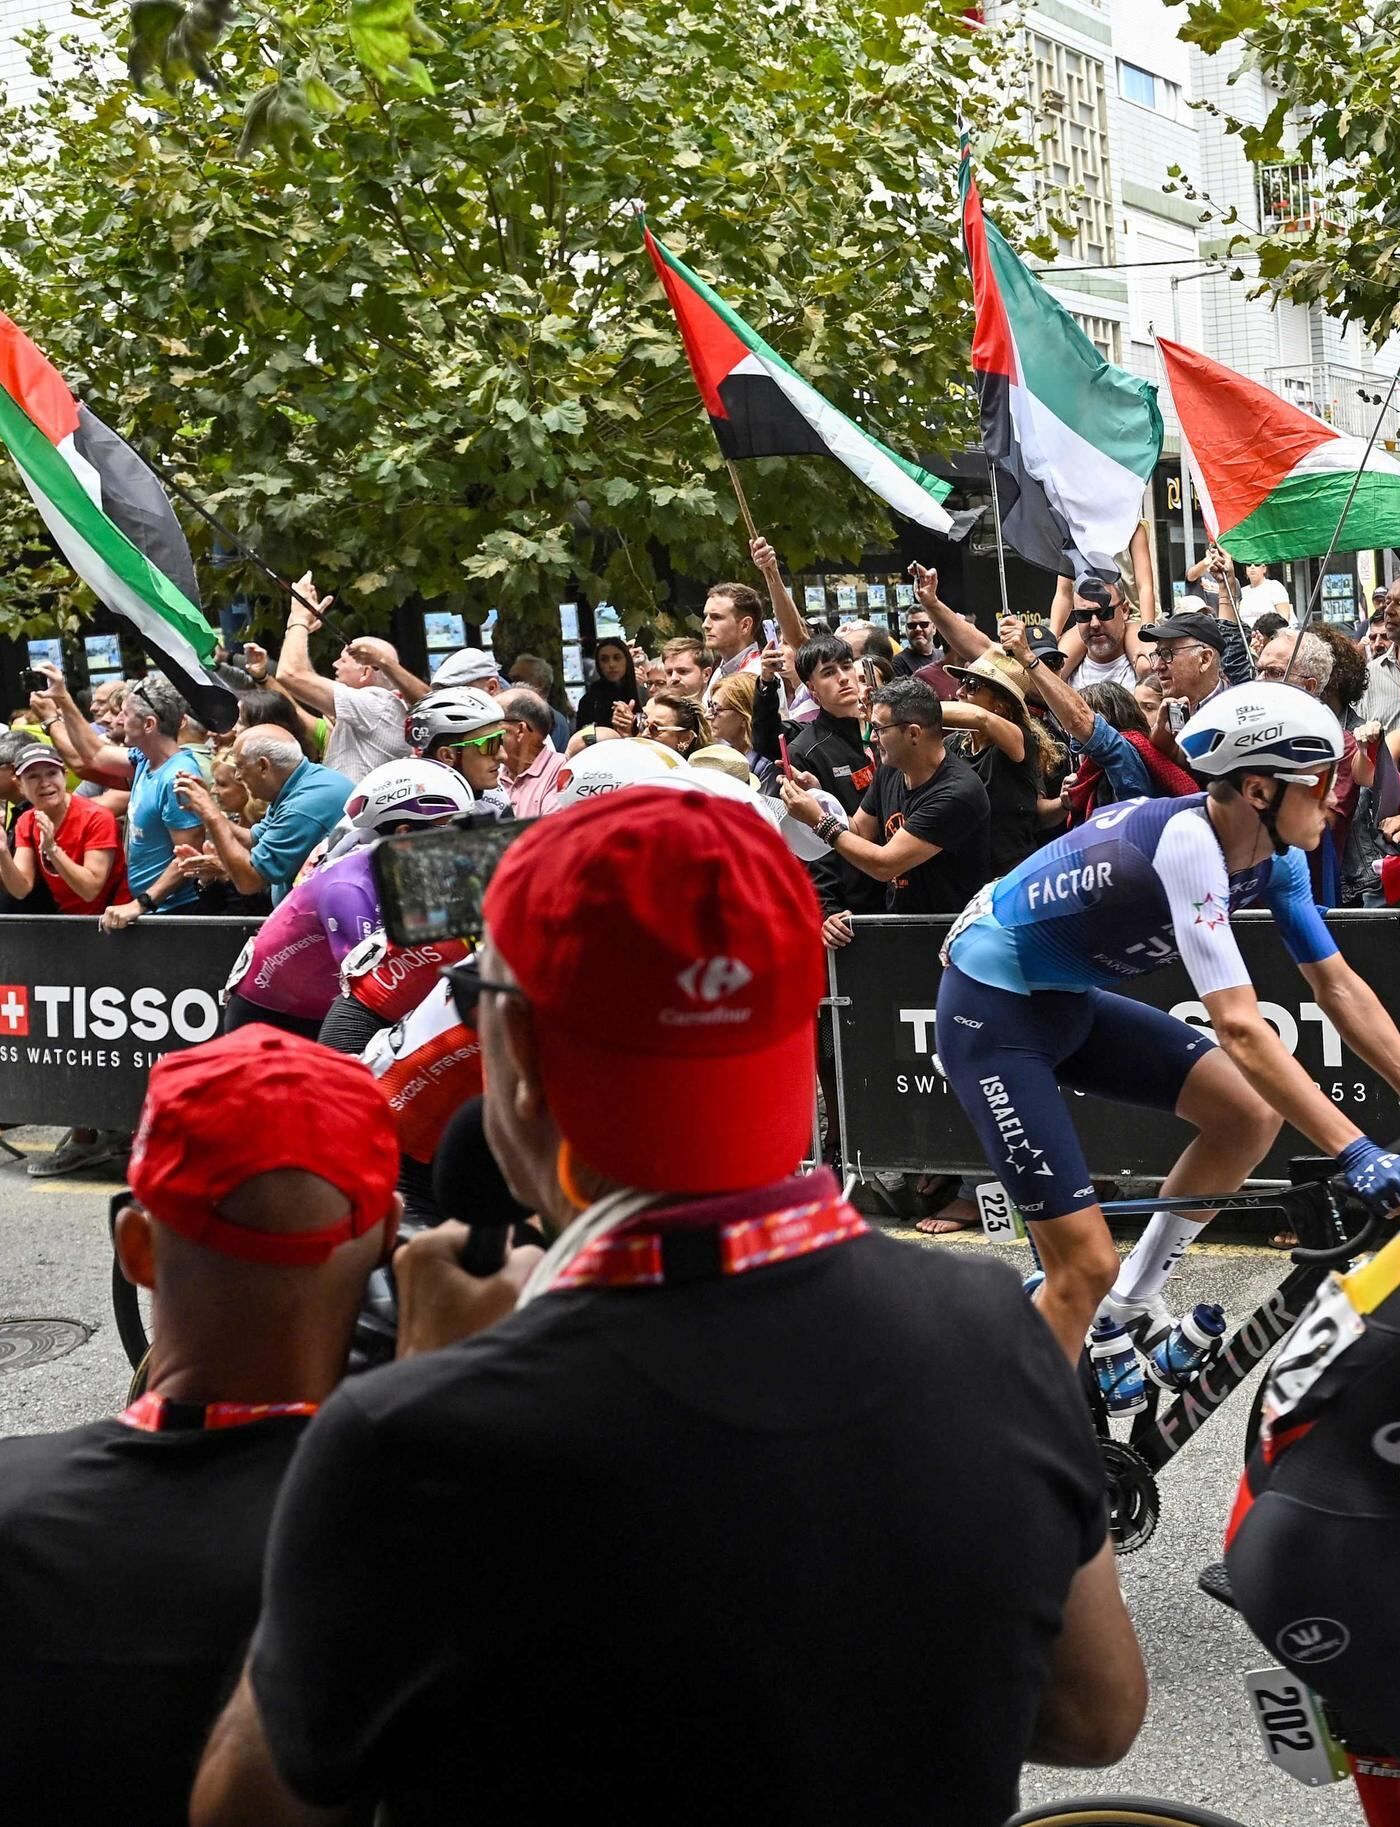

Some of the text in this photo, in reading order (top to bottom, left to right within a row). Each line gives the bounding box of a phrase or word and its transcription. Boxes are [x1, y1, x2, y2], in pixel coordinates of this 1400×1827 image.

[1029, 862, 1113, 909] FACTOR
[34, 985, 227, 1042] TISSO
[27, 1048, 121, 1067] WATCHES
[134, 1051, 168, 1068] SIN
[897, 1075, 947, 1094] SWI
[979, 1075, 1025, 1143] ISRAEL
[982, 1193, 1011, 1233] 223
[1203, 1198, 1260, 1209] VAM
[1156, 1288, 1298, 1452] FACTOR
[1255, 1687, 1315, 1754] 202
